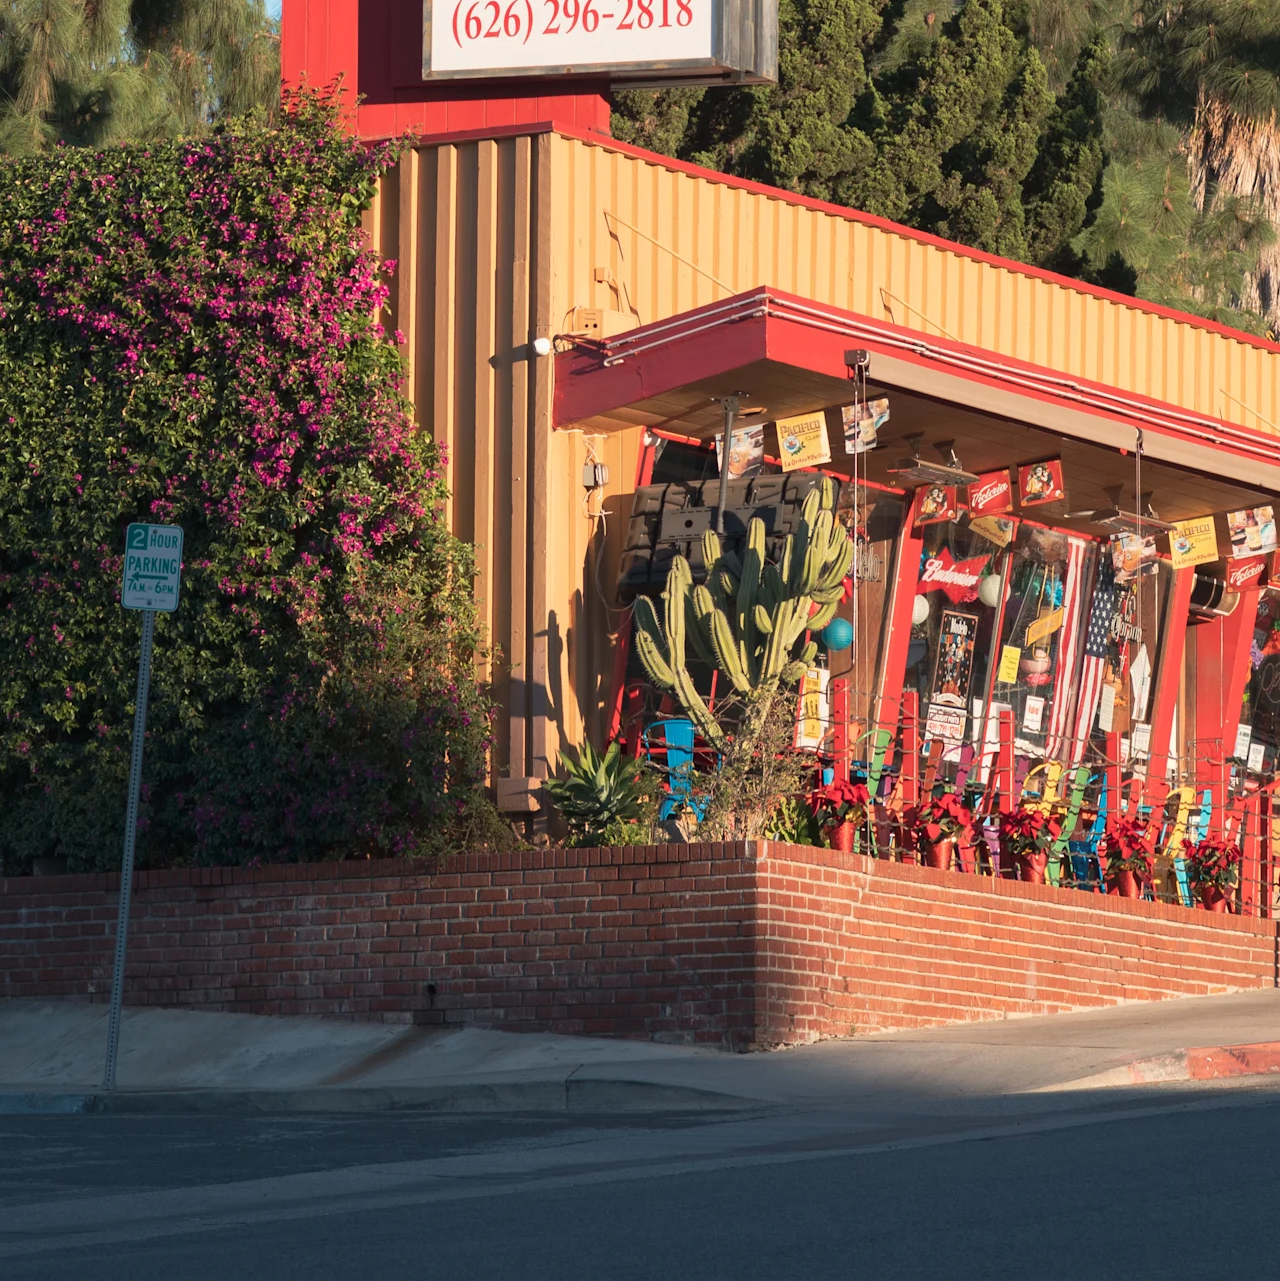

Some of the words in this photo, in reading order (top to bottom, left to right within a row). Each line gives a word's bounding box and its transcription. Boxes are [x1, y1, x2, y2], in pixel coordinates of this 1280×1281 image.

[972, 480, 1008, 509] Victoria
[132, 529, 146, 547] 2
[150, 534, 178, 548] HOUR
[128, 556, 177, 574] PARKING
[922, 559, 978, 587] Budweiser
[1230, 562, 1265, 586] Victoria
